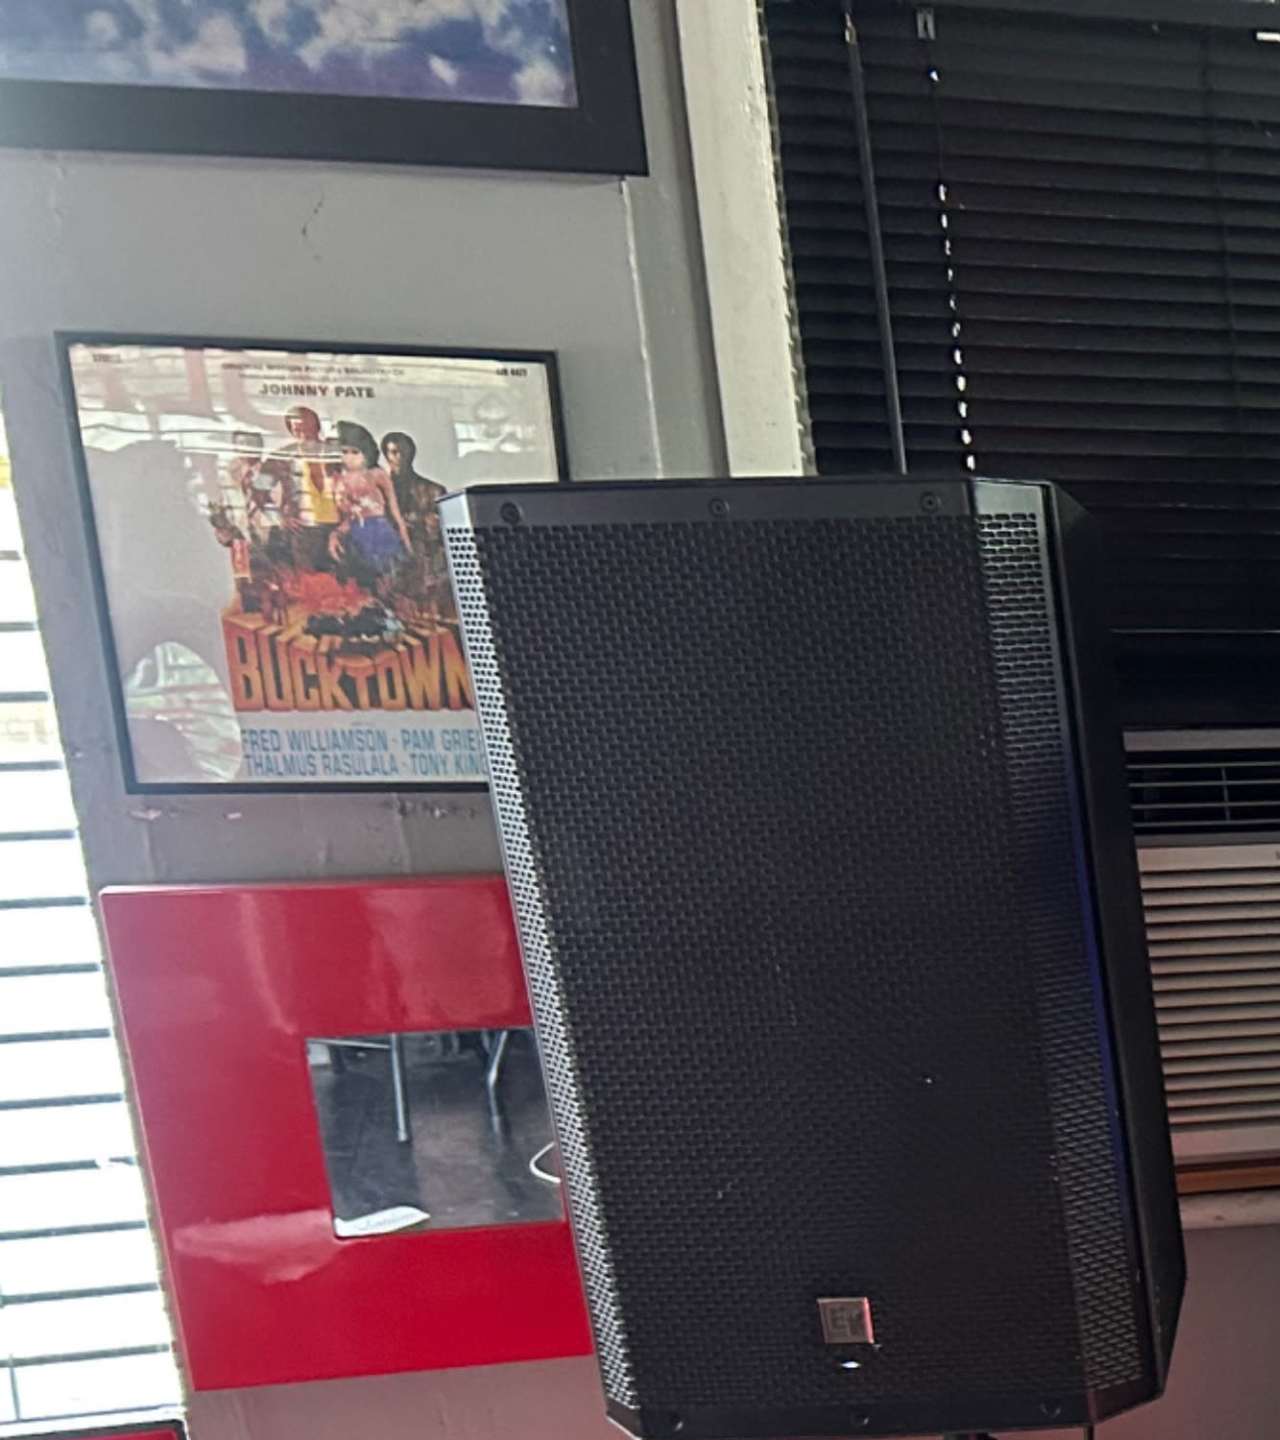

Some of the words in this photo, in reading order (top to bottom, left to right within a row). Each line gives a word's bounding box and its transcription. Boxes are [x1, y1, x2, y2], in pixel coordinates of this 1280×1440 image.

[259, 382, 329, 399] JOHNNY
[334, 384, 376, 399] PATE
[222, 612, 478, 711] BUCKTOWN
[241, 729, 280, 752] FRED
[286, 729, 388, 752] WILLIAMSON
[401, 730, 435, 752] PAM
[441, 730, 480, 752] GRIE
[243, 754, 318, 777] THALMUS
[322, 754, 399, 777] RASULALA
[410, 754, 449, 777] TONY
